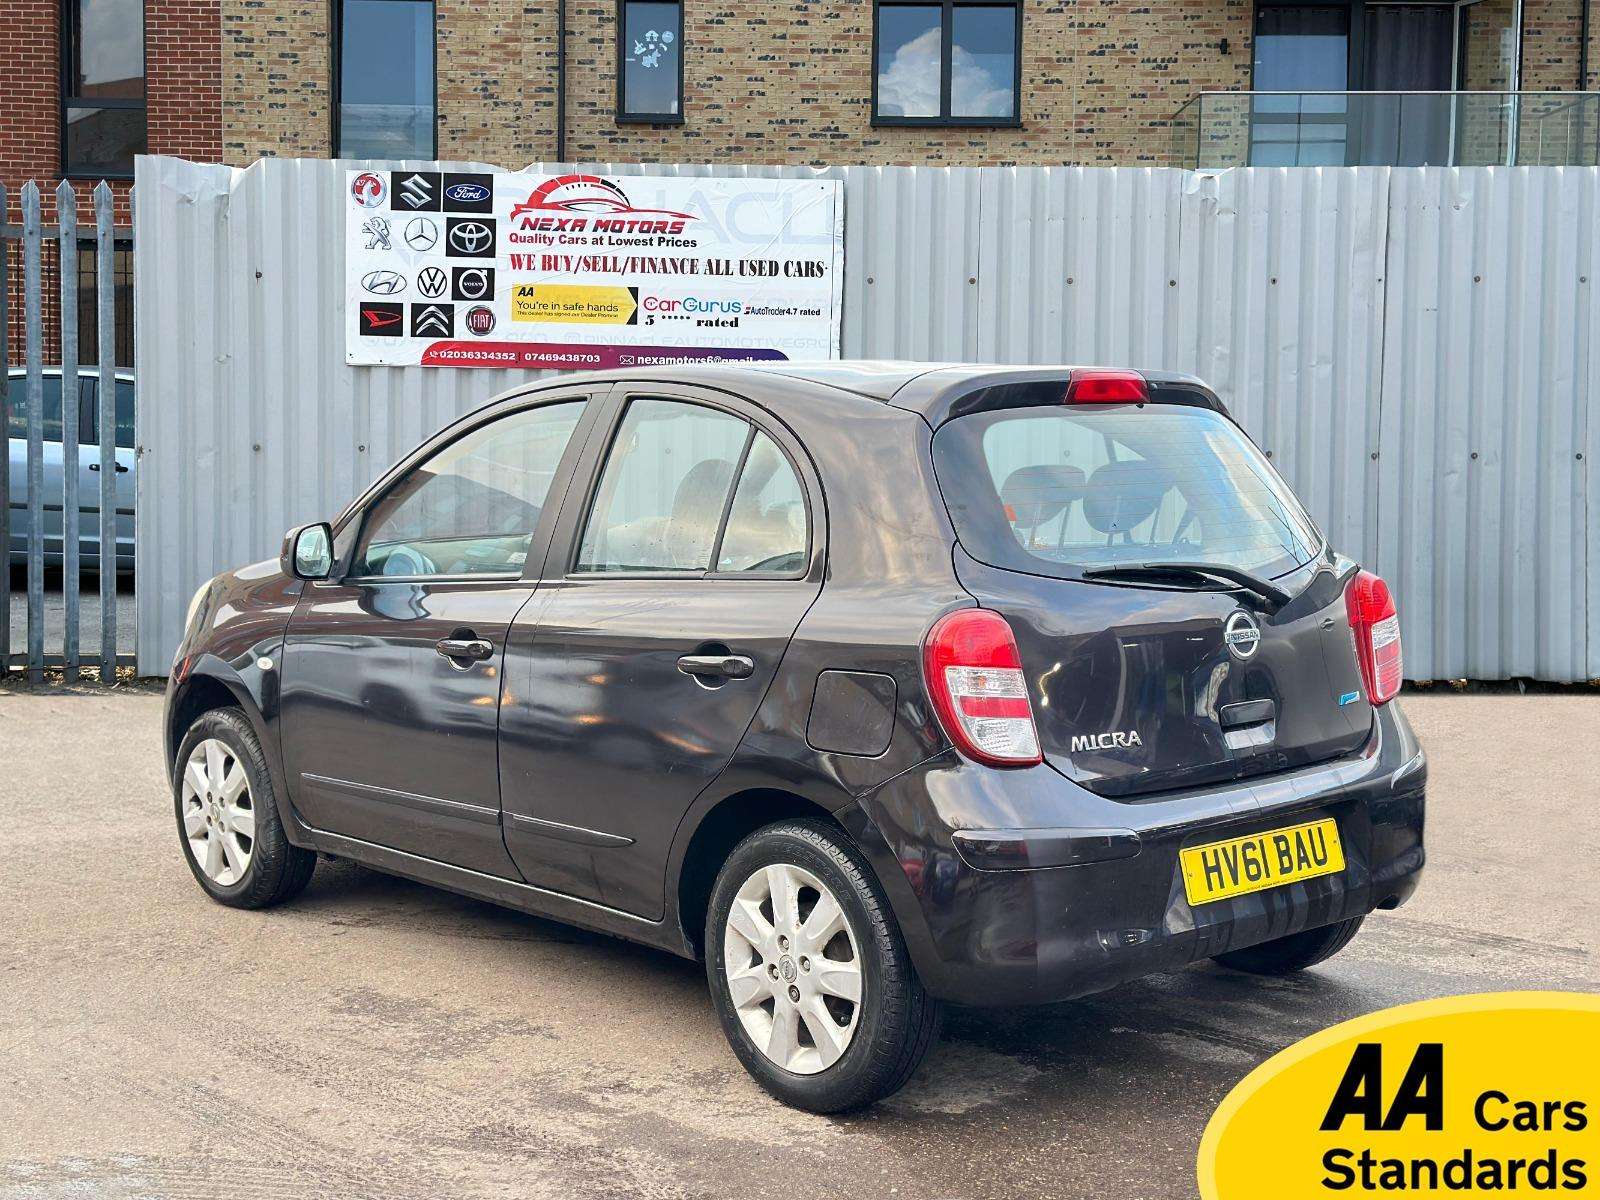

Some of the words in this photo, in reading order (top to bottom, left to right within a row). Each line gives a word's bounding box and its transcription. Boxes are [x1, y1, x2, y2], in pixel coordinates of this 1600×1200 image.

[454, 186, 482, 199] Ford
[520, 217, 588, 232] NEXA
[592, 219, 686, 235] MOTORS
[509, 232, 555, 246] Quality
[558, 233, 588, 246] Cars
[591, 234, 604, 247] at
[608, 235, 654, 248] Lowest
[657, 236, 698, 248] Prices
[510, 253, 536, 271] WE
[541, 254, 699, 276] BUY/SELL/FINANCE
[704, 258, 734, 276] ALL
[739, 259, 779, 277] USED
[518, 286, 534, 297] AA
[516, 300, 549, 310] You're
[551, 301, 561, 310] in
[563, 302, 585, 311] safe
[587, 302, 619, 312] hands
[643, 296, 742, 313] CarGurus
[799, 308, 821, 316] rated
[473, 314, 490, 328] FIAT
[644, 314, 656, 326] 5
[696, 316, 739, 328] rated
[440, 351, 516, 361] 02036334352
[524, 352, 601, 363] 07469438703
[1071, 730, 1143, 753] MICRA
[1201, 838, 1271, 892] HV61
[1273, 826, 1328, 876] BAU
